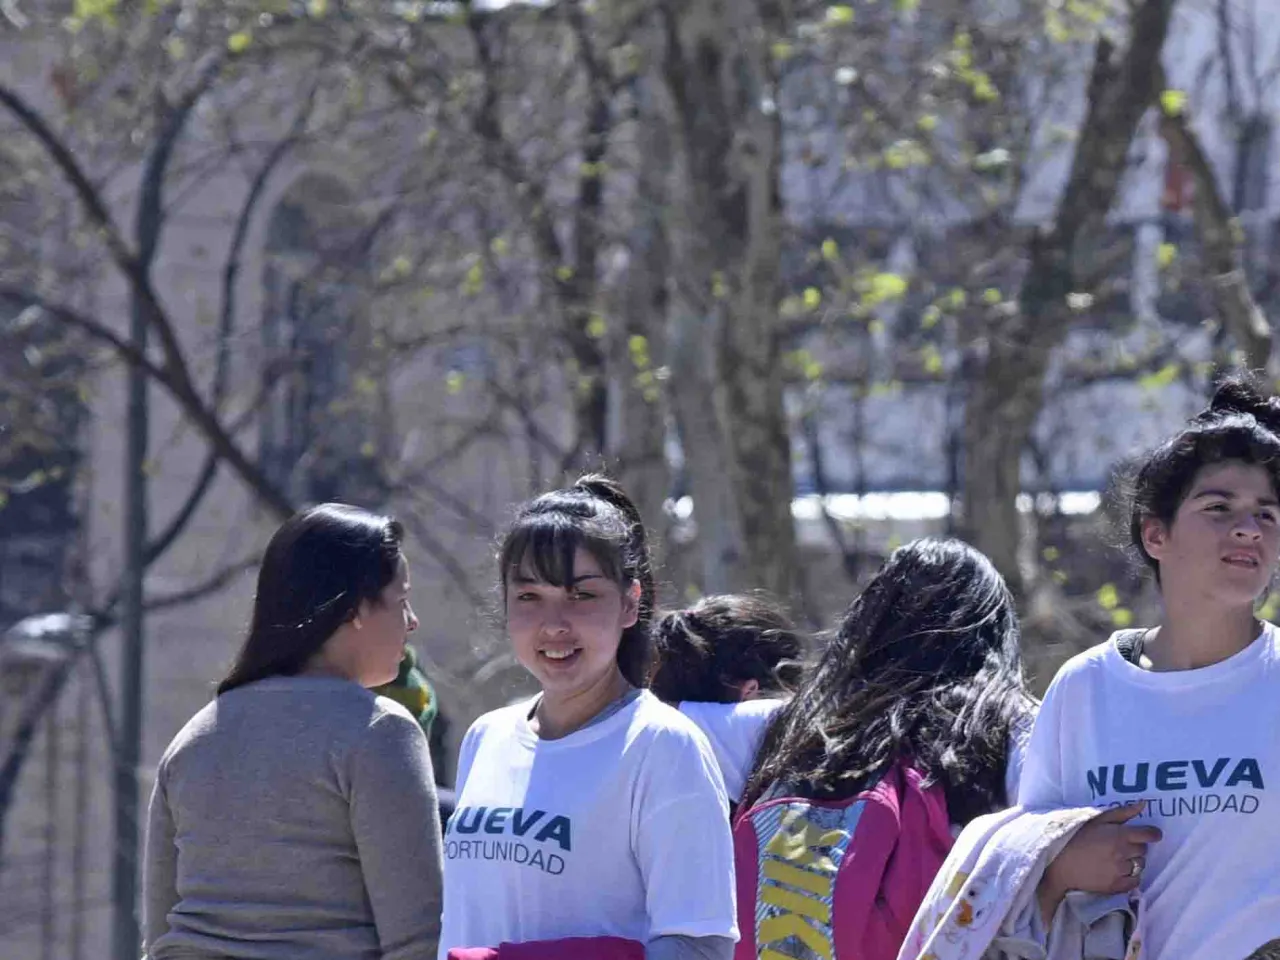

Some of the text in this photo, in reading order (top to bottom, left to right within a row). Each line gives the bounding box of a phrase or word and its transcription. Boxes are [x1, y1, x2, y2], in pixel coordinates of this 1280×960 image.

[1087, 757, 1265, 800] NUEVA
[1097, 793, 1260, 818] TUNIDAD
[443, 840, 566, 875] ORTUNIDAD
